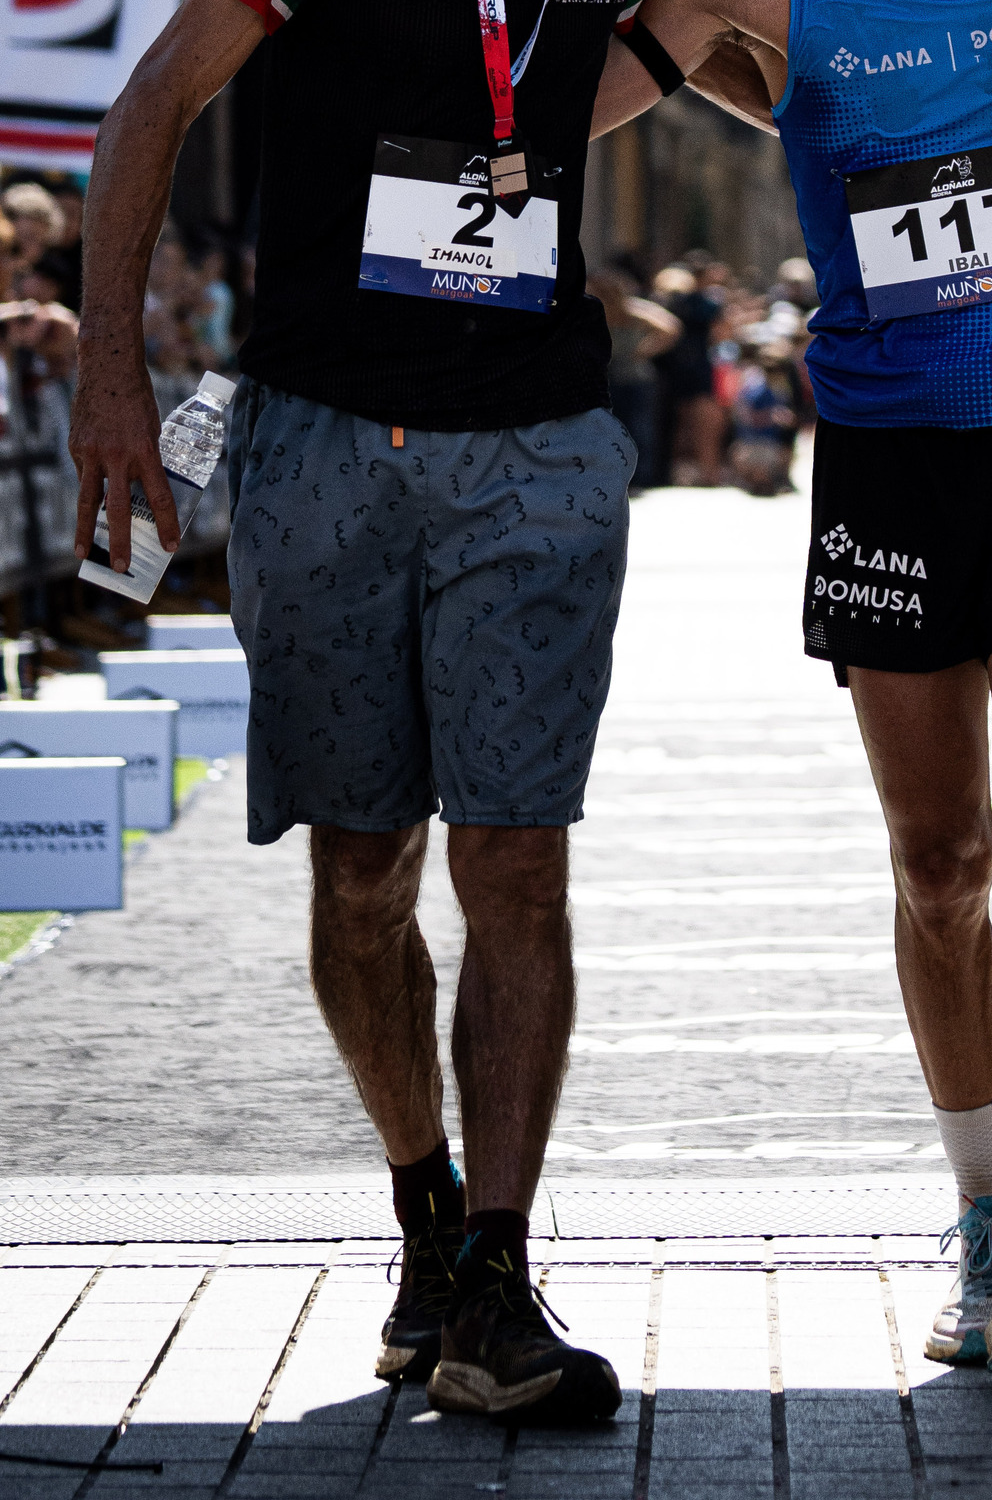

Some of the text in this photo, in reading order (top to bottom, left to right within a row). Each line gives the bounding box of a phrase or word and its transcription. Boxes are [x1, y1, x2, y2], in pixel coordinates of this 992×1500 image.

[864, 47, 933, 75] LANA
[930, 178, 976, 194] ALOÑAKO
[451, 192, 497, 248] 2
[428, 248, 493, 269] IMANOL
[948, 252, 990, 272] IBAI
[430, 287, 475, 299] margoak
[937, 294, 981, 307] margoak
[853, 545, 928, 580] LANA
[814, 575, 924, 615] DOMUSA
[811, 600, 923, 630] TEKNIK
